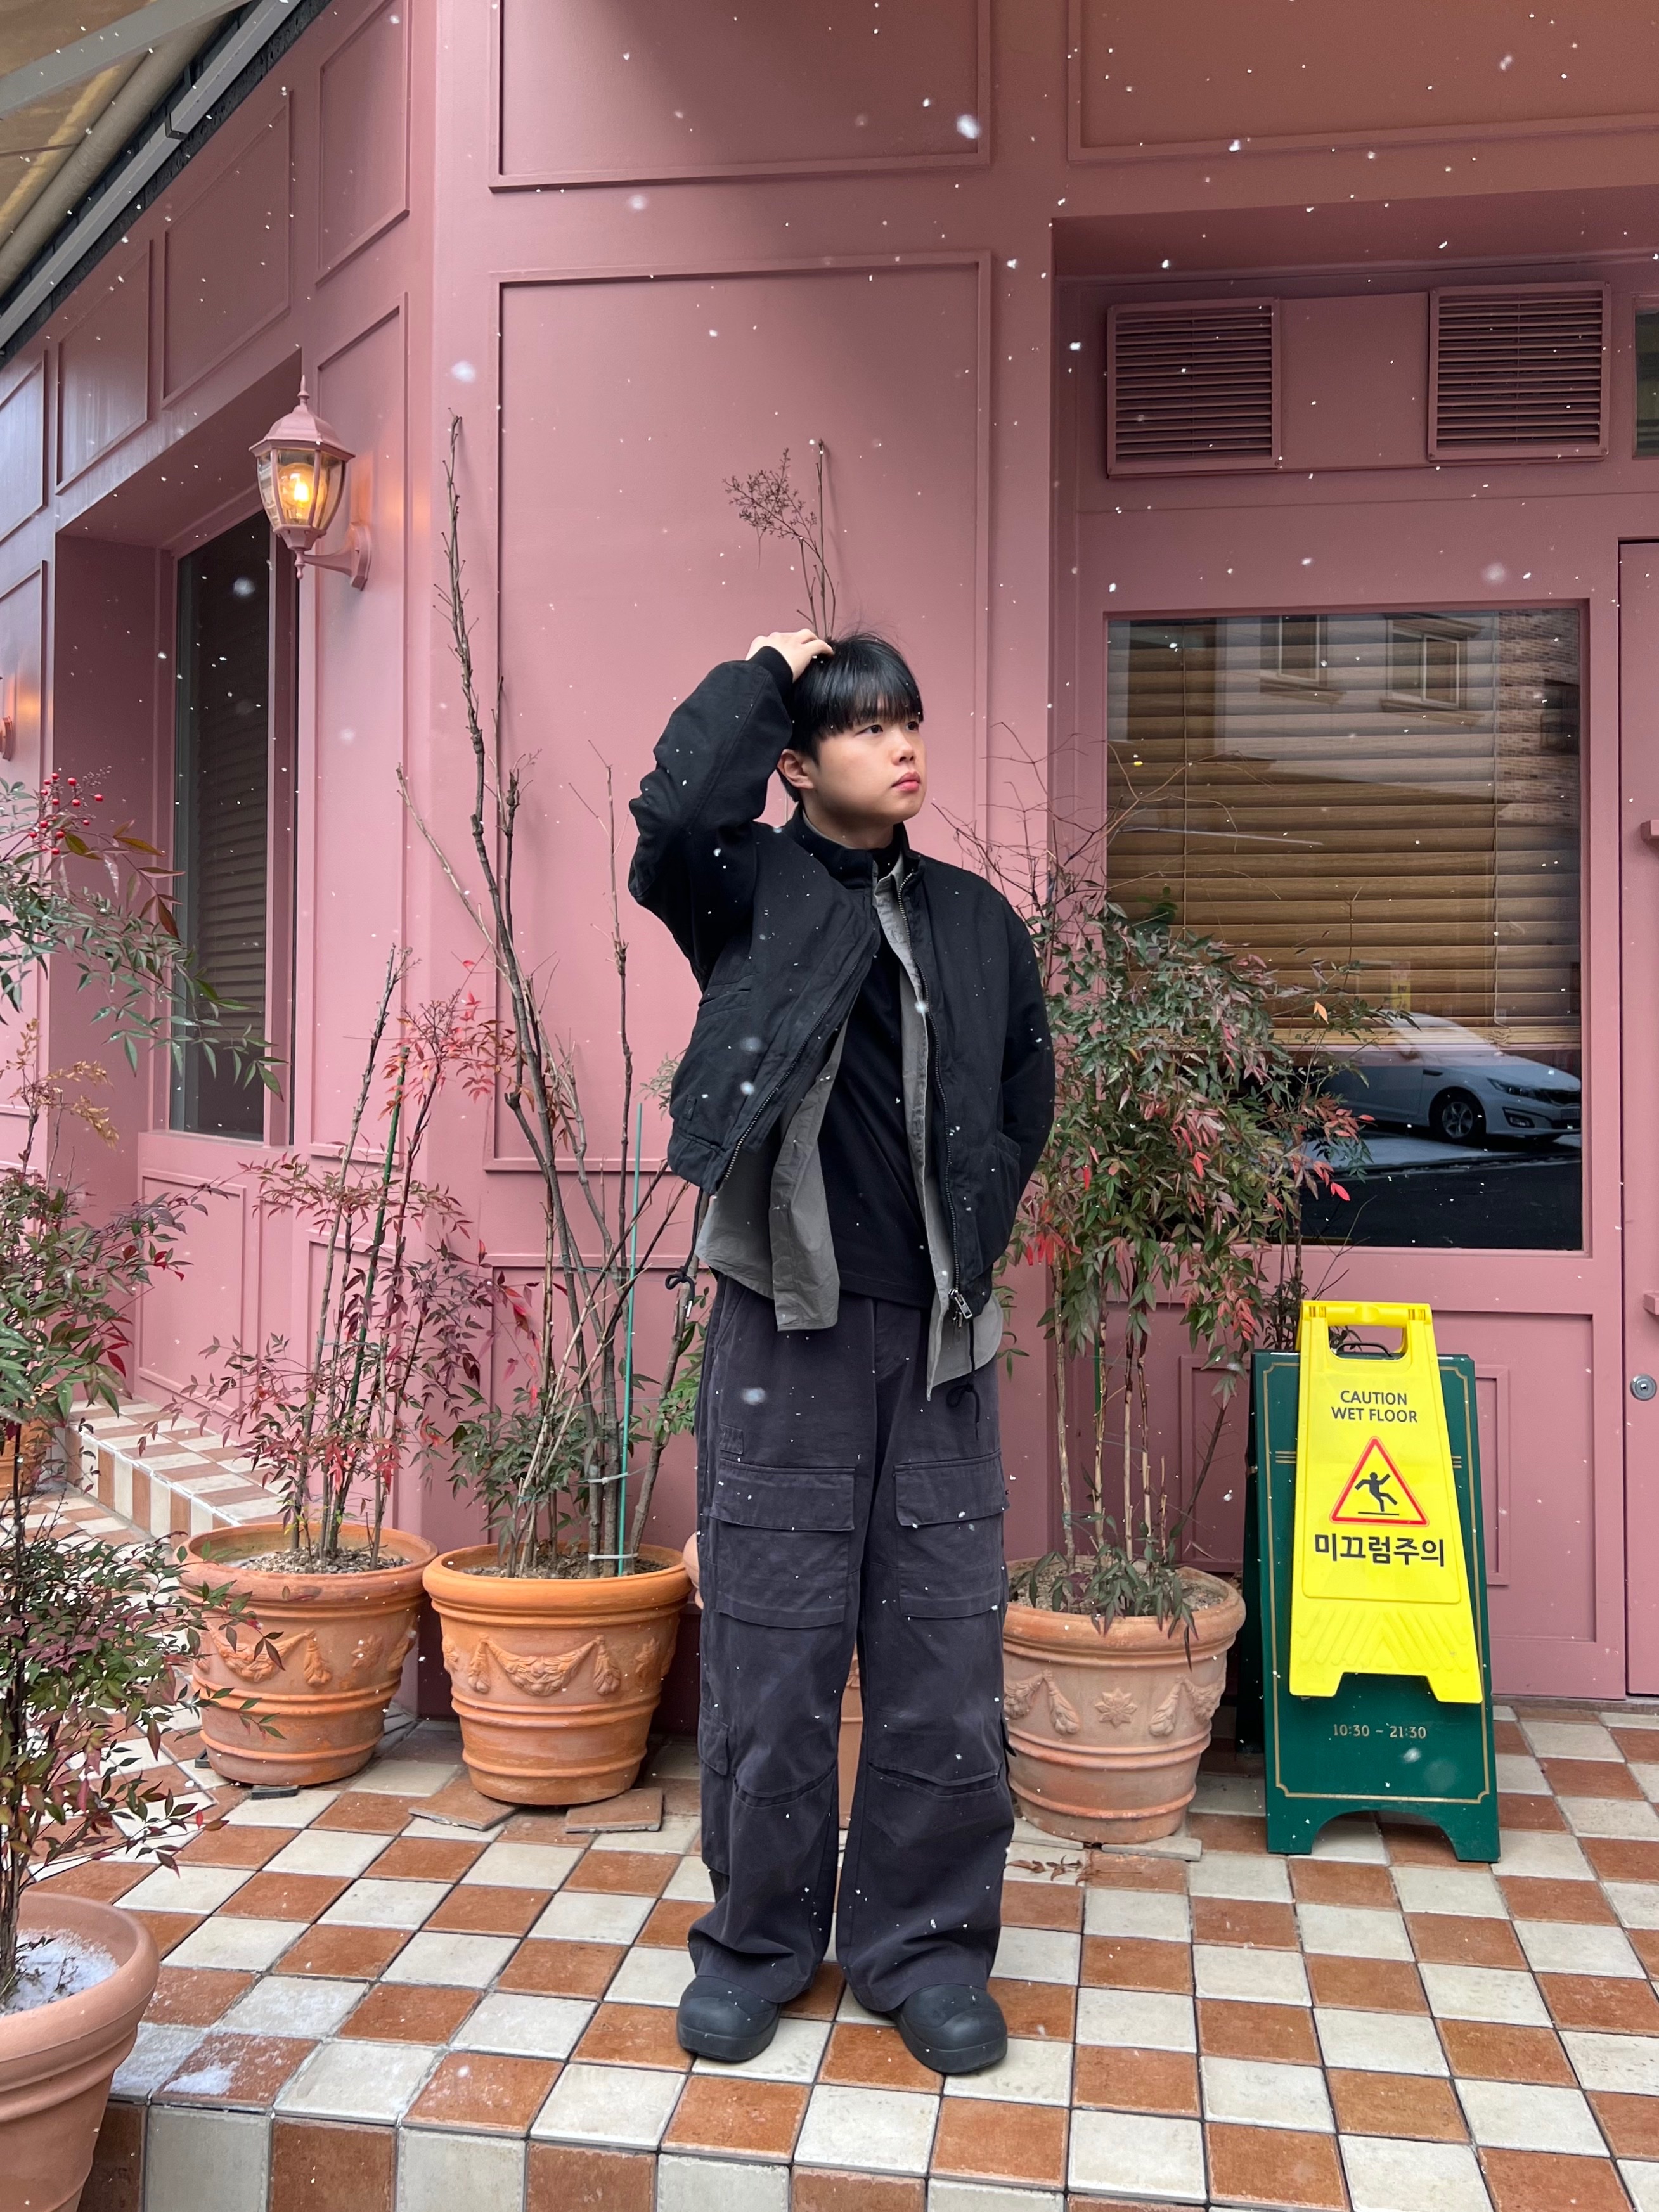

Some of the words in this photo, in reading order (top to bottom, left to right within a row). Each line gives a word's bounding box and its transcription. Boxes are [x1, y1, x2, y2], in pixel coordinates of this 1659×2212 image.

[1340, 1390, 1407, 1405] CAUTION
[1331, 1406, 1364, 1420] WET
[1369, 1408, 1418, 1423] FLOOR
[1315, 1533, 1444, 1567] 미끄럼주의
[1333, 1723, 1370, 1737] 10:30
[1390, 1725, 1426, 1739] 21:30
